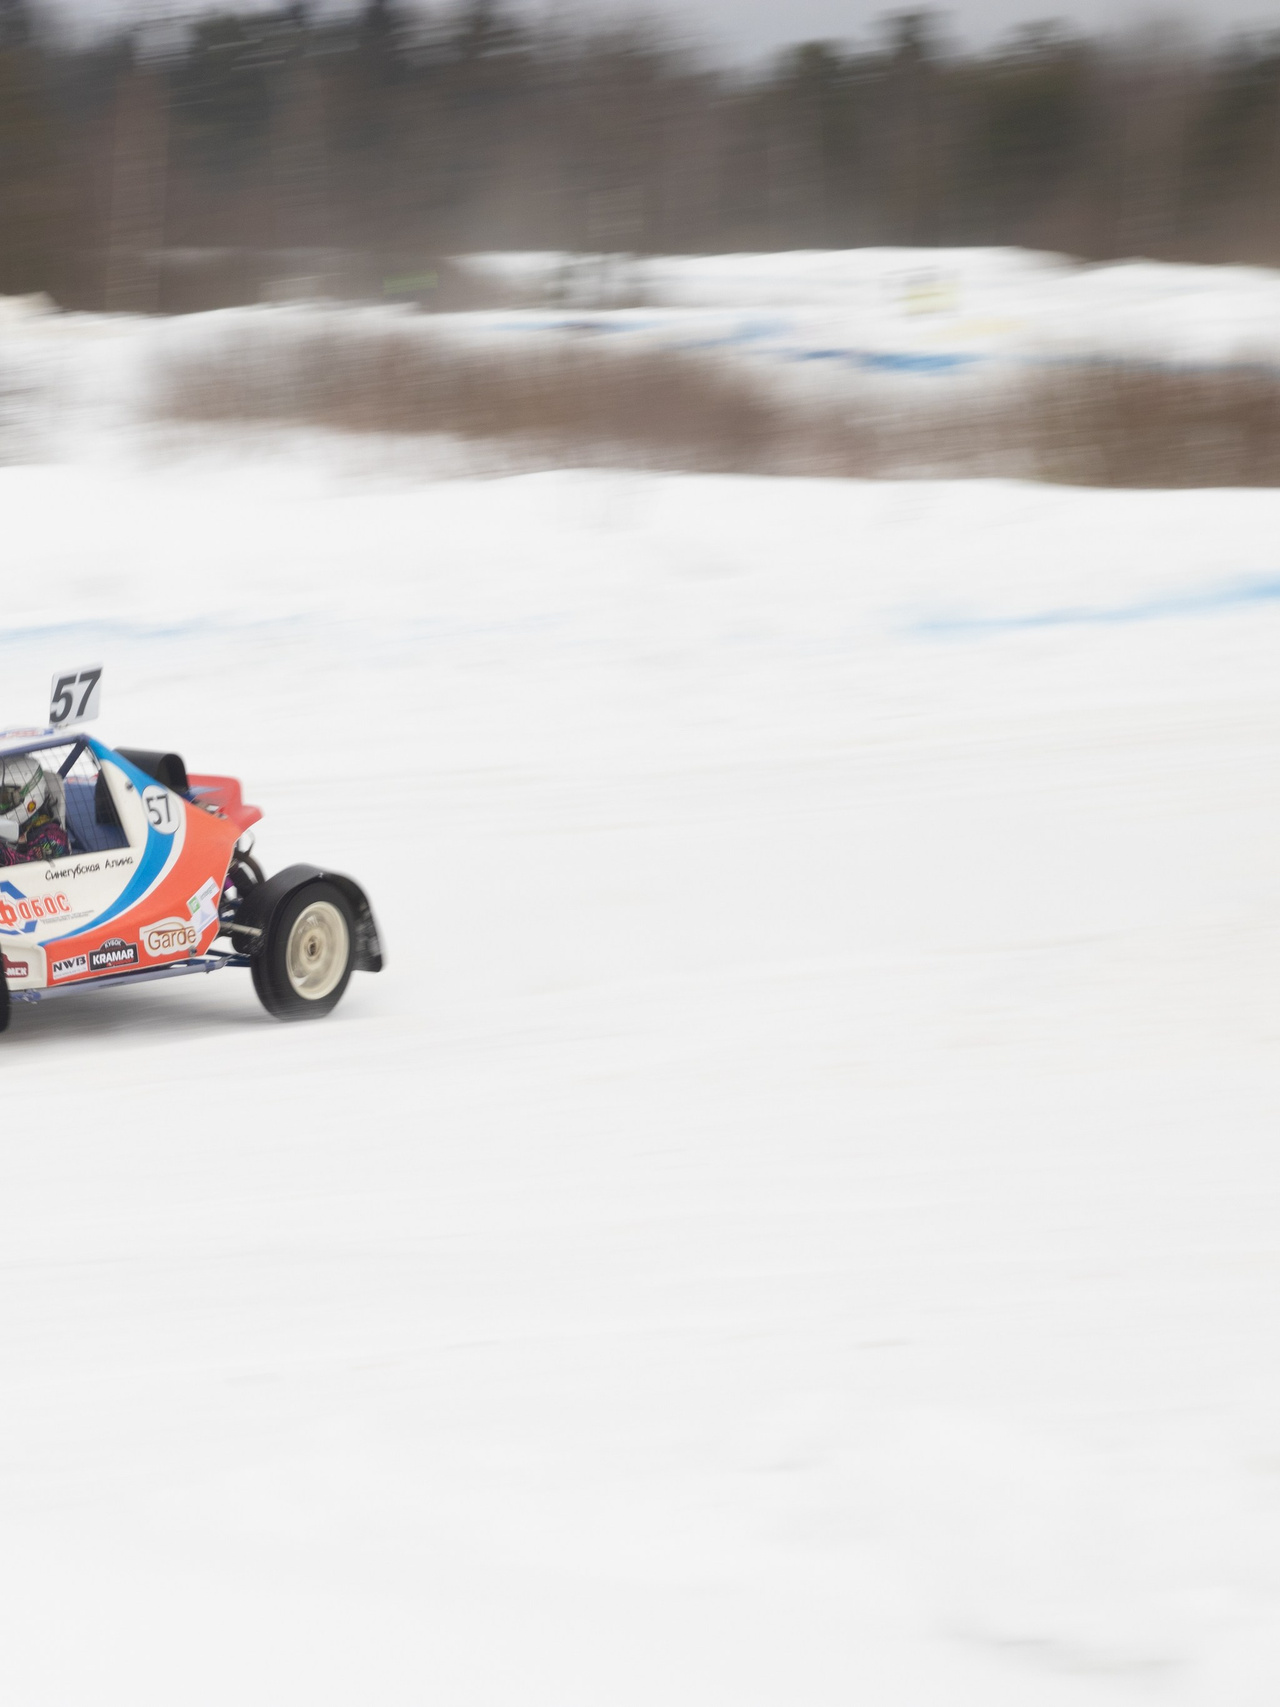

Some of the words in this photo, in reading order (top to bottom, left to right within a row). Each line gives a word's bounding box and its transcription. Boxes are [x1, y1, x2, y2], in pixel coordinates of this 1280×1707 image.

[49, 668, 102, 723] 57
[146, 794, 171, 825] 57
[45, 863, 101, 881] Синегубская
[104, 856, 134, 869] Алина
[147, 927, 197, 951] Garde
[52, 956, 87, 974] NWB
[92, 948, 134, 966] KRAMAR
